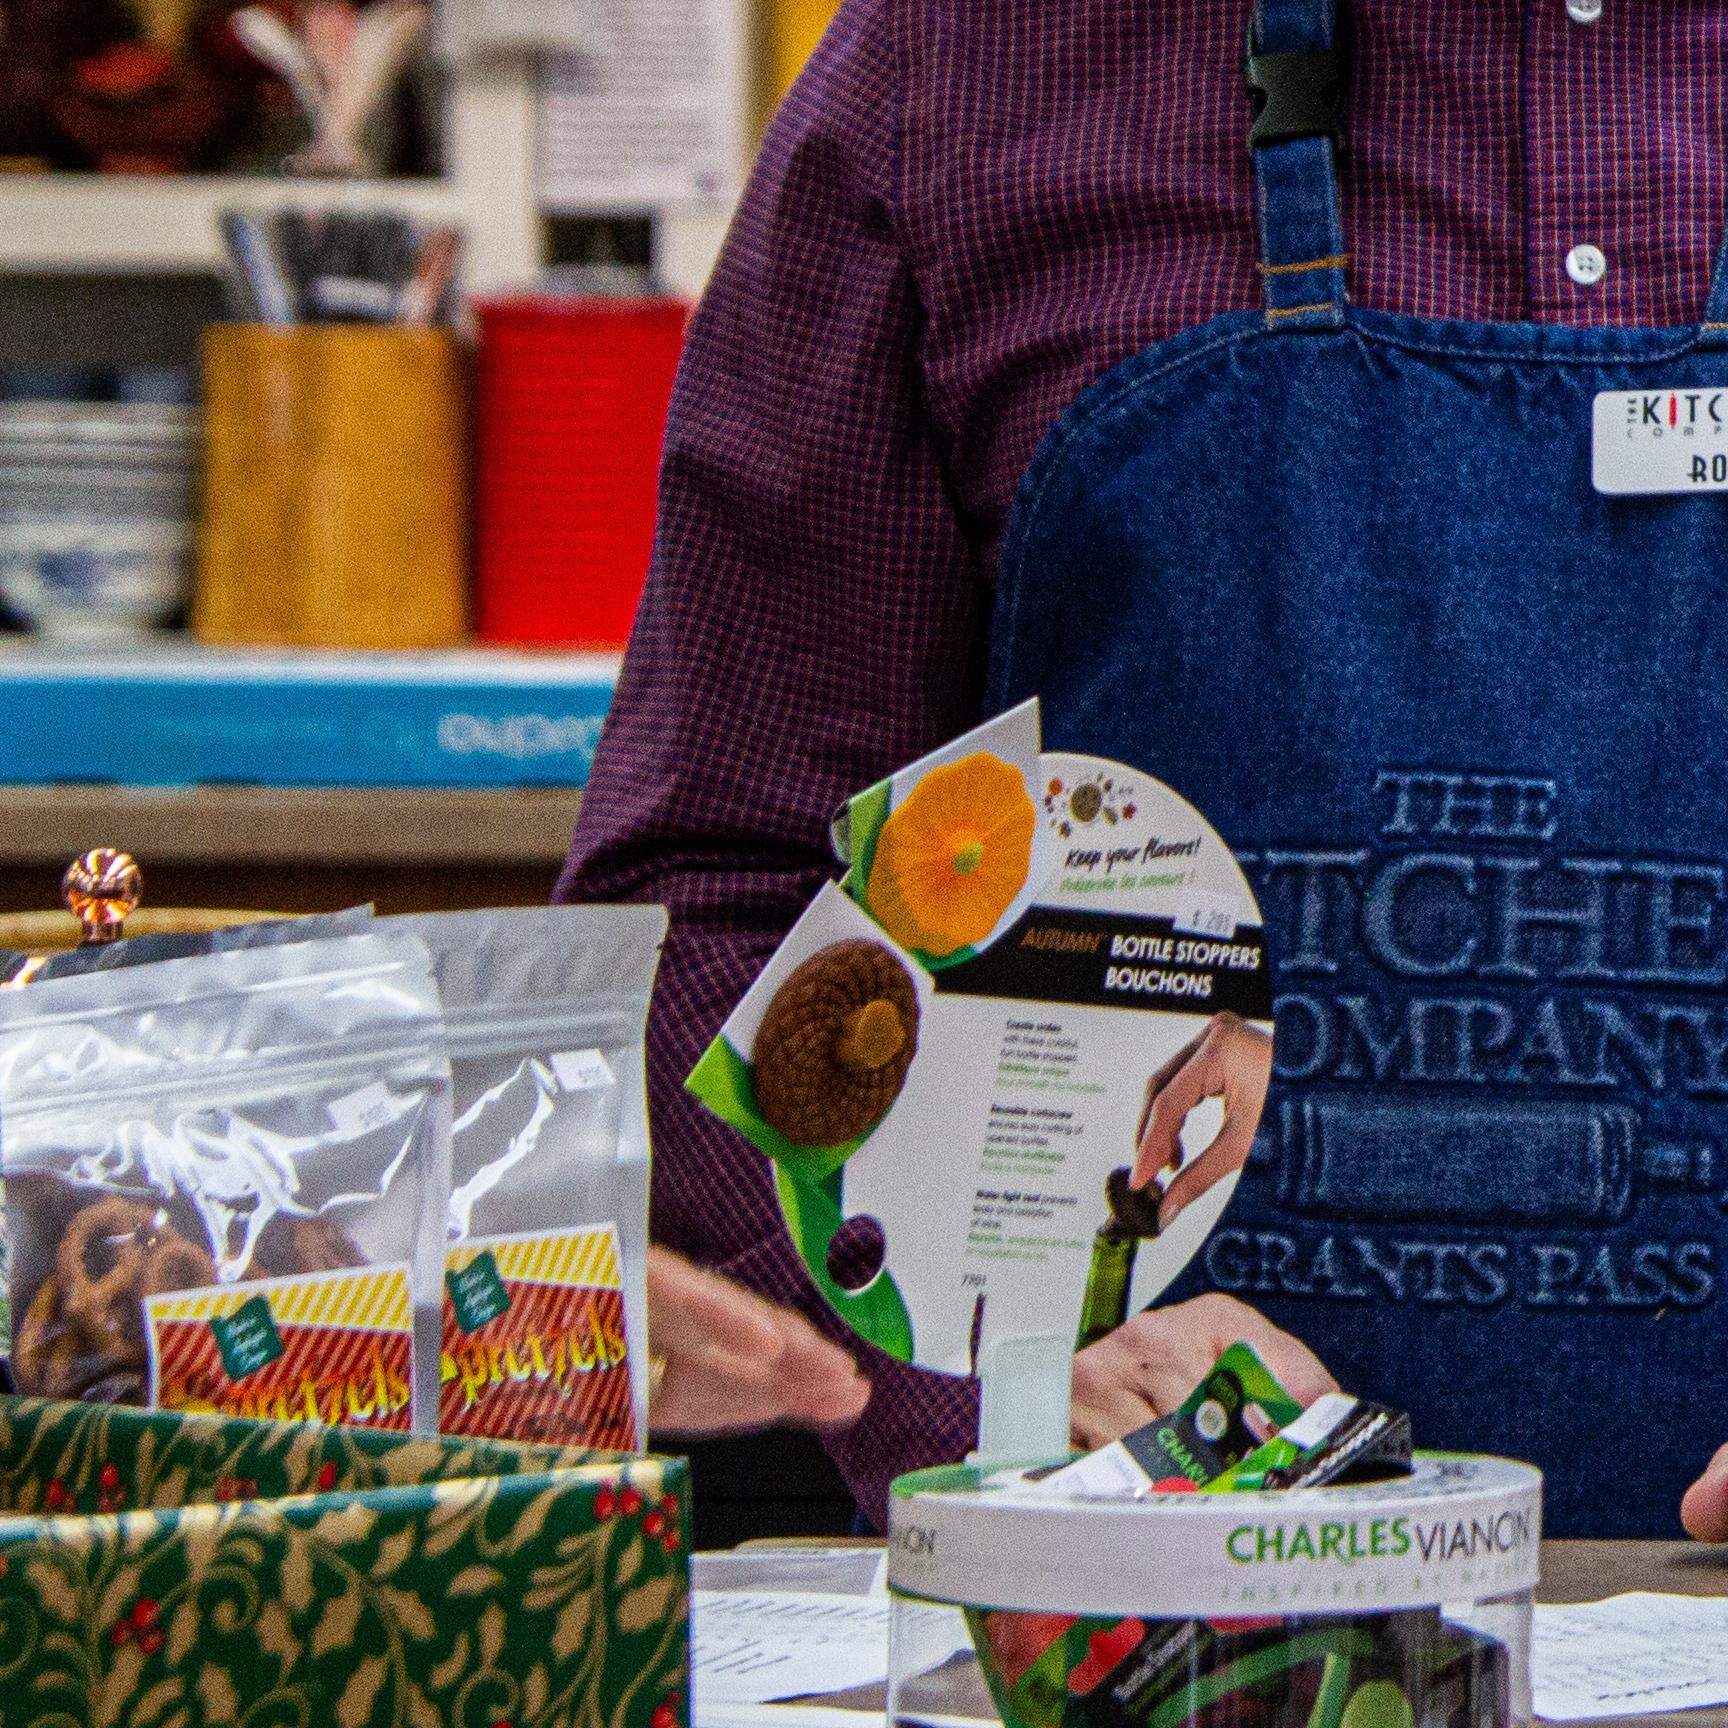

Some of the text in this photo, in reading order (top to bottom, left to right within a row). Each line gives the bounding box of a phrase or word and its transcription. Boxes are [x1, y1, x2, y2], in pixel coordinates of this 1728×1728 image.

[1376, 769, 1557, 839] THE
[1065, 838, 1202, 872] Keep your flavors!
[1021, 928, 1262, 971] AUTUMN BOTTLE STOPPERS
[1105, 967, 1213, 998] BOUCHONS
[1206, 1229, 1716, 1306] GRANTS PASS
[455, 1308, 627, 1413] pretzels
[1225, 1517, 1412, 1565] CHARLES
